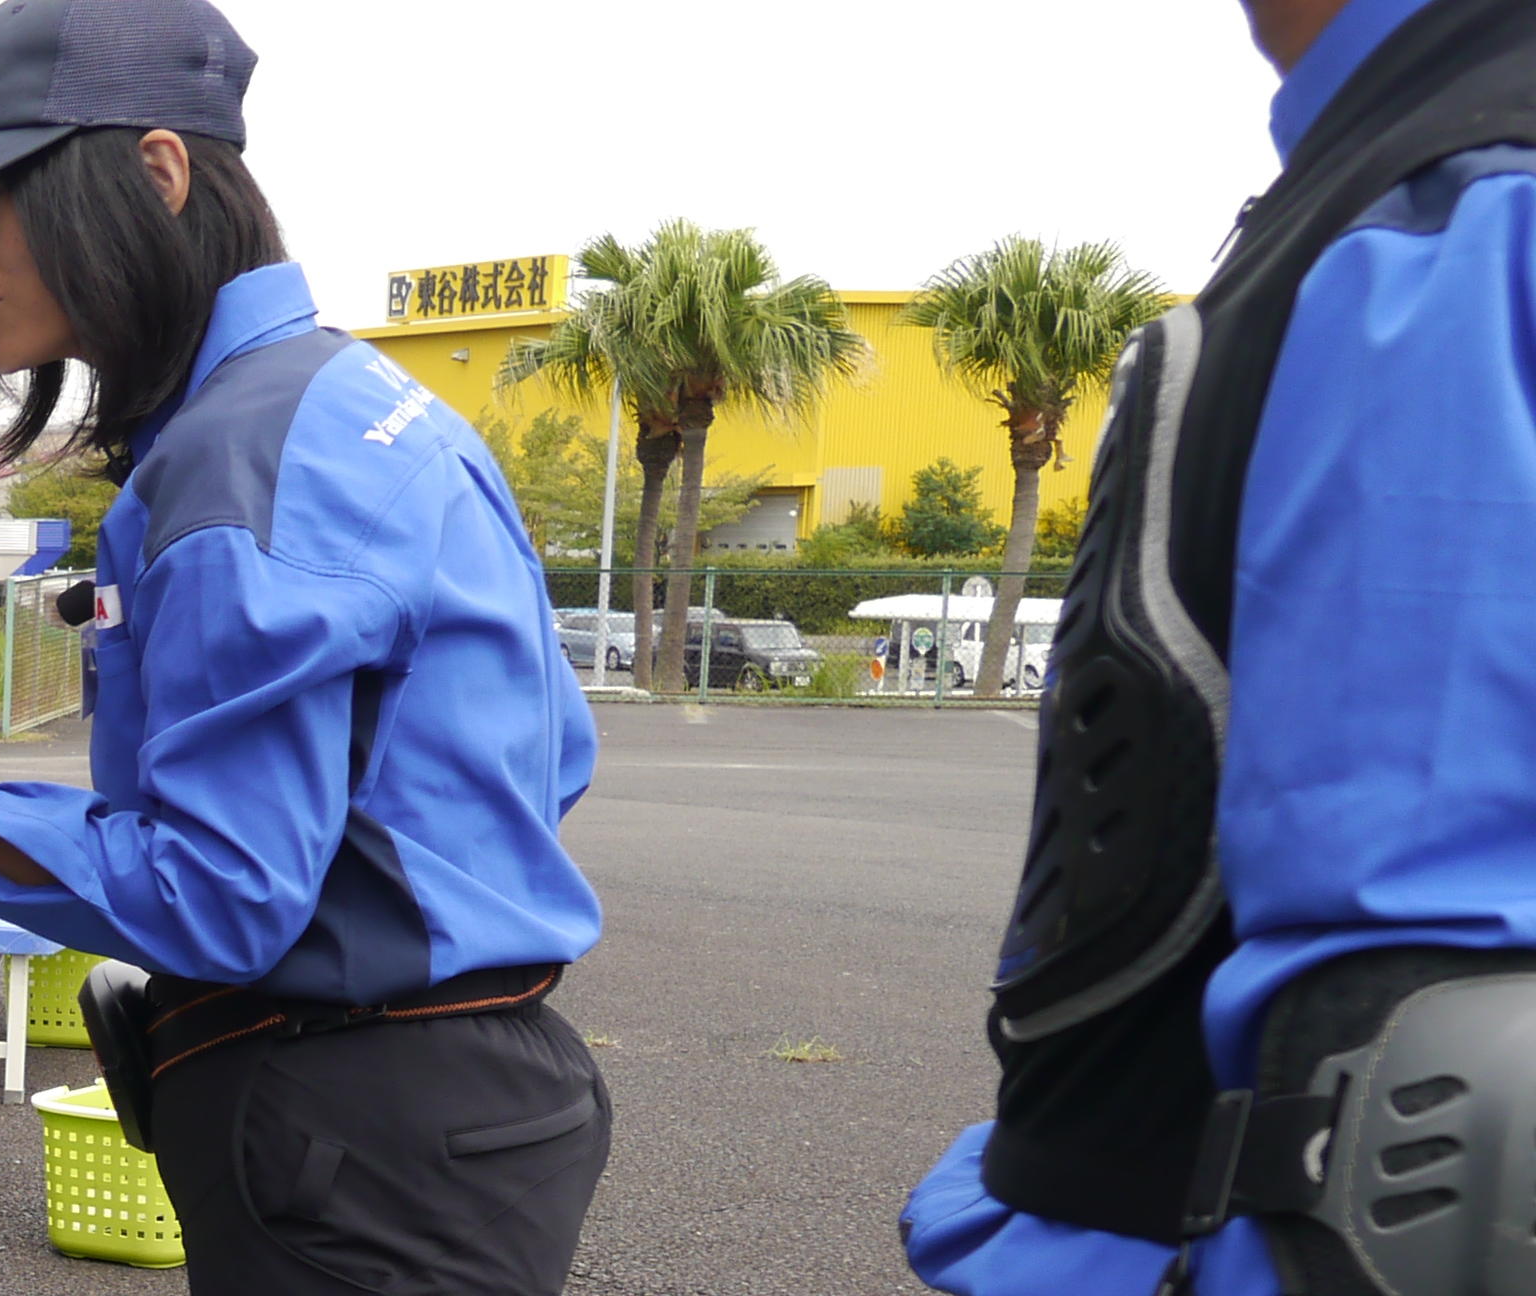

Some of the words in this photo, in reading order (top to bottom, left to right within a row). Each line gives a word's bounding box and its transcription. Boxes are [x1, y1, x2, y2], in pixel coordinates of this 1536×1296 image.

[416, 256, 549, 317] 東谷株式会社
